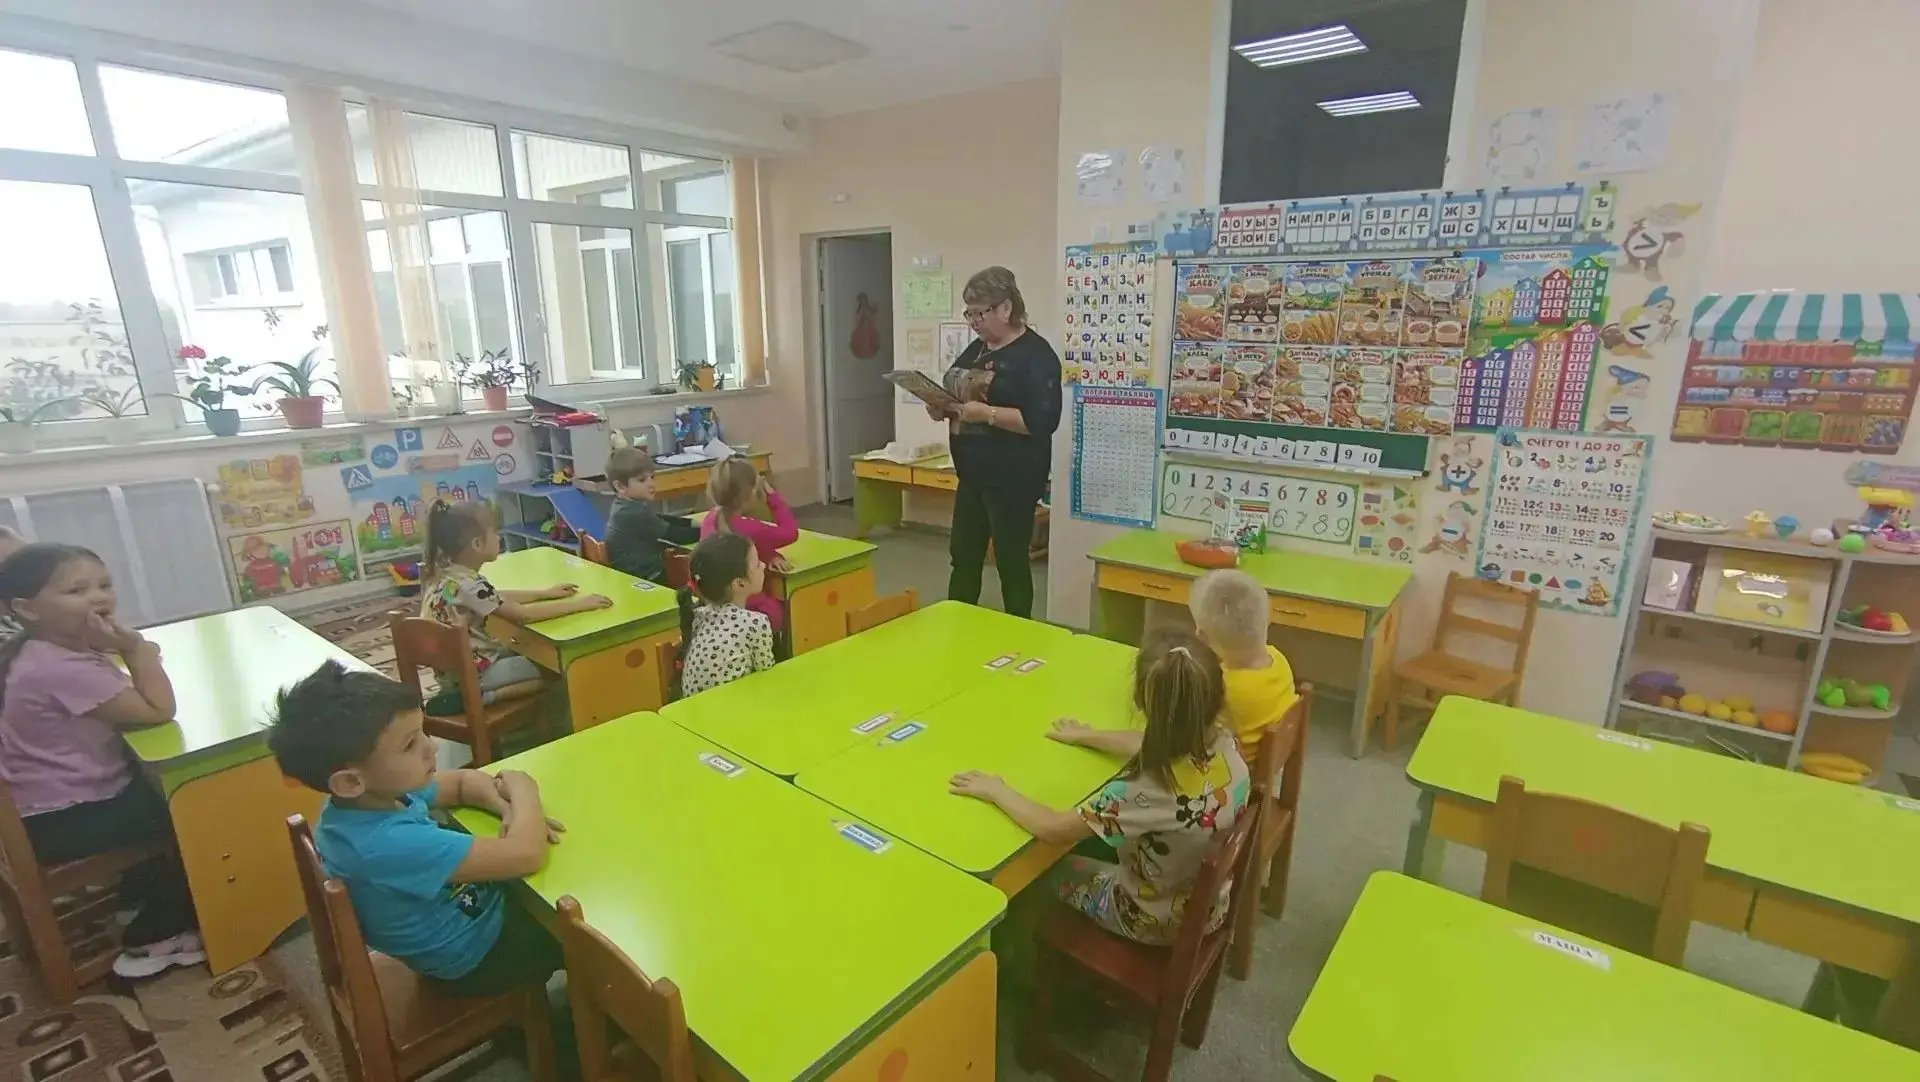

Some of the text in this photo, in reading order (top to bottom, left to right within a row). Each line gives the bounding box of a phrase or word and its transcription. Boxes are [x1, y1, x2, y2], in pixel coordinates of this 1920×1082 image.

[1596, 199, 1608, 208] Ъ
[1366, 211, 1373, 219] Б
[1401, 209, 1409, 217] Г
[1418, 208, 1428, 217] Д
[1445, 206, 1458, 216] Ж
[1497, 216, 1572, 231] Х Ц Ч Щ
[1592, 218, 1601, 227] Ь
[1381, 227, 1390, 235] Ф
[1417, 225, 1425, 234] Т
[1442, 224, 1455, 233] Ш
[1068, 259, 1075, 268] А
[1085, 257, 1091, 266] Б
[1102, 256, 1108, 265] В
[1120, 255, 1126, 264] Г
[1068, 277, 1073, 286] Е
[1101, 276, 1109, 285] Ж
[1137, 275, 1144, 284] И
[1084, 296, 1090, 305] К
[1101, 295, 1108, 304] Л
[1119, 295, 1126, 304] М
[1137, 294, 1144, 304] Н
[1067, 314, 1144, 324] О П Р С Т
[1066, 333, 1072, 342] У
[1100, 334, 1107, 342] Х
[1117, 334, 1124, 343] Ц
[1135, 333, 1142, 342] Ч
[1065, 351, 1074, 360] Ш
[1082, 352, 1091, 362] Щ
[1117, 352, 1125, 361] Ы
[1135, 353, 1142, 362] Ь
[1083, 370, 1124, 380] Э Ю Я
[402, 430, 417, 449] P
[1170, 432, 1176, 440] 0
[1203, 436, 1209, 444] 2
[1222, 439, 1228, 448] 3
[1241, 440, 1248, 449] 4
[1261, 441, 1268, 450] 5
[1281, 444, 1288, 454] 6
[1303, 446, 1310, 455] 7
[1320, 447, 1328, 456] 8
[1345, 450, 1352, 459] 9
[1362, 452, 1377, 463] 10
[1583, 442, 1601, 451] ДО
[1530, 453, 1537, 462] 2
[1557, 455, 1564, 463] 3
[1614, 459, 1622, 468] 5
[1172, 470, 1348, 508] 0 1 2 3 4 5 6 7 8 9
[1501, 474, 1507, 482] 6
[1553, 479, 1561, 488] 8
[1581, 481, 1588, 490] 9
[1609, 483, 1624, 493] 10
[1498, 497, 1617, 517] 11 12 13 14 15
[1273, 509, 1288, 528] 6
[1333, 517, 1350, 537] 9
[1494, 520, 1614, 541] 16 17 18 19 20
